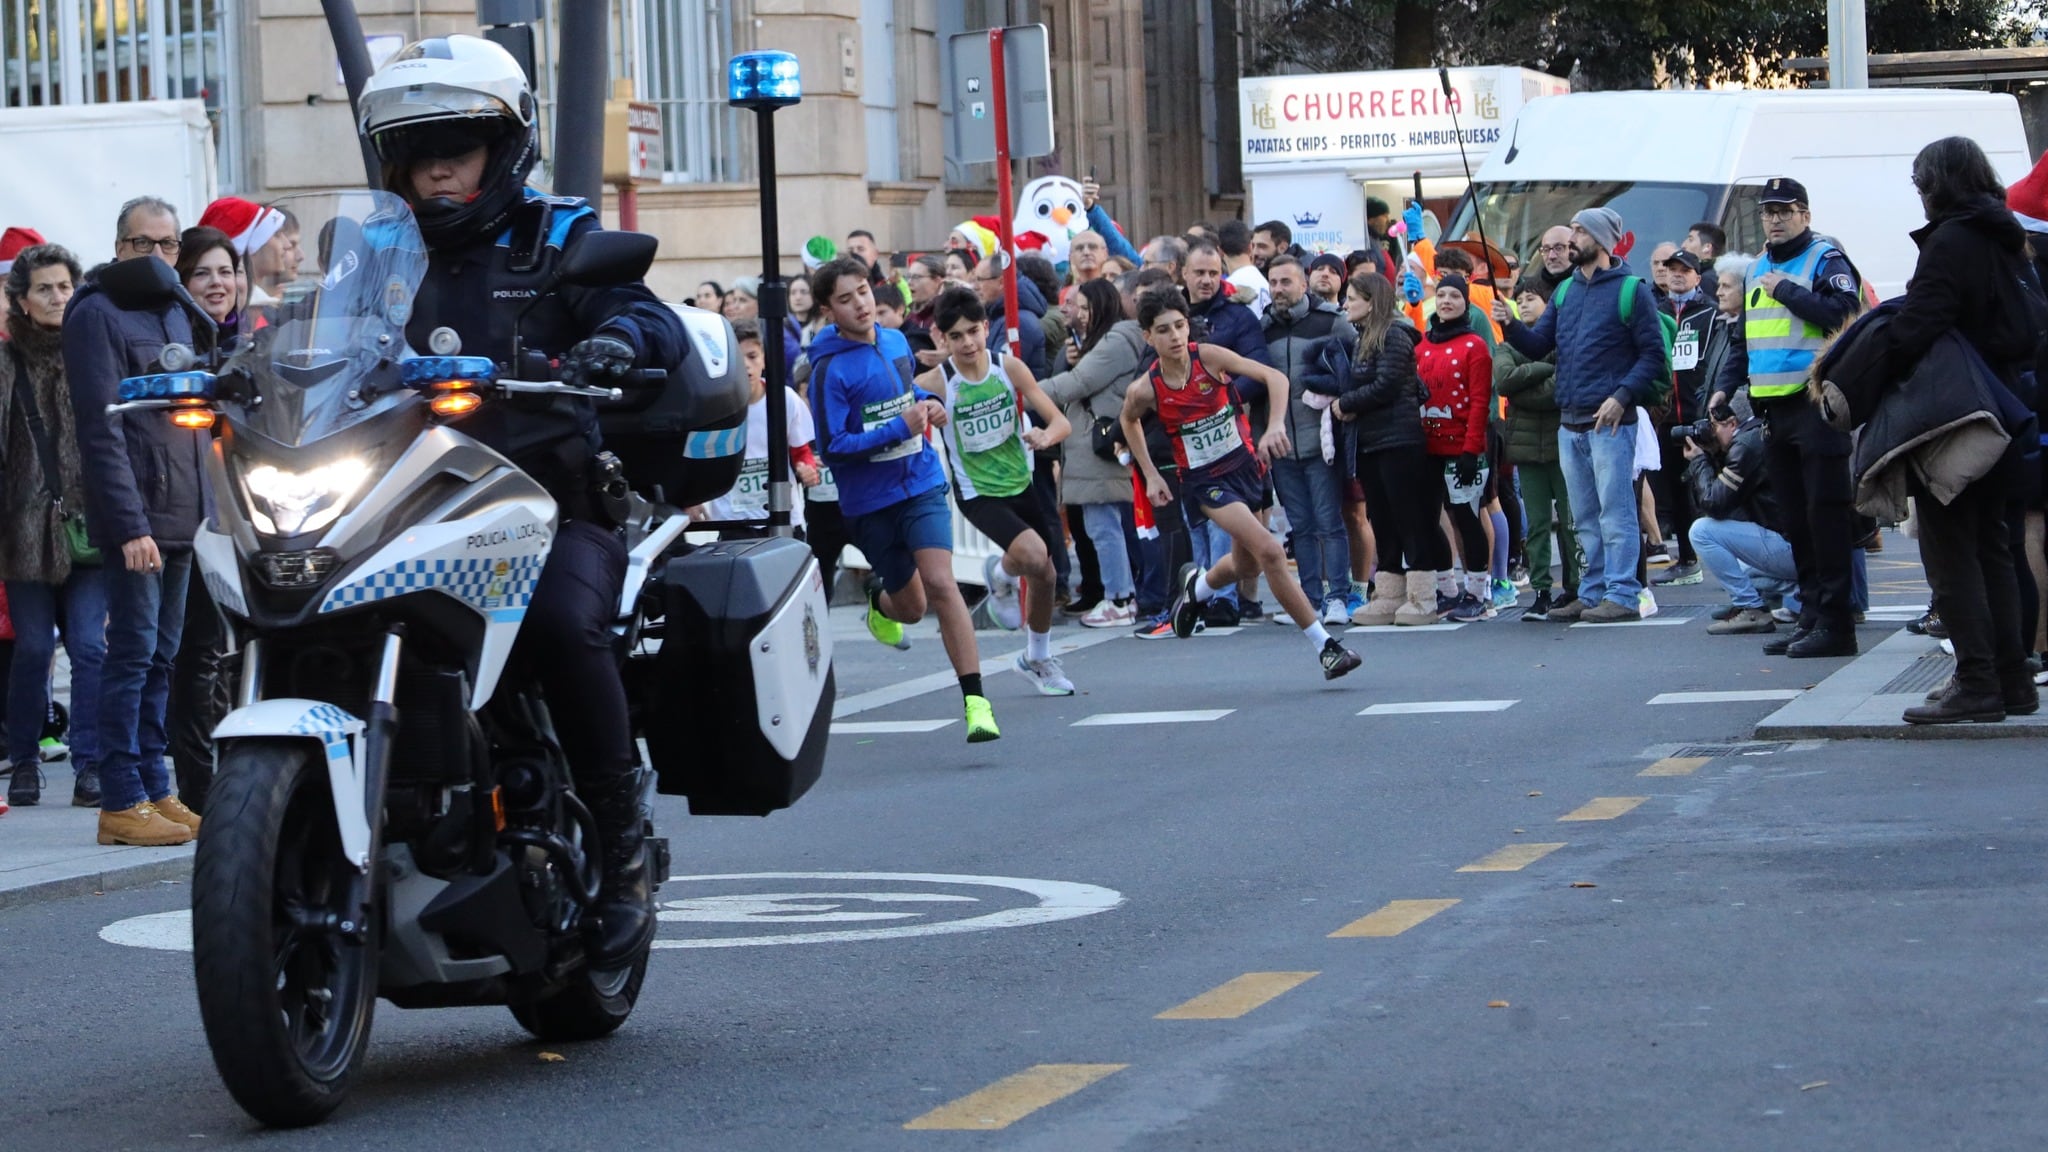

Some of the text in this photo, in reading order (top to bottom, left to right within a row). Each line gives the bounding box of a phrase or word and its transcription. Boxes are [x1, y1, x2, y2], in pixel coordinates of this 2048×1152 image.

[1283, 87, 1462, 122] CHURRERIA
[1248, 138, 1292, 154] PATATAS
[1296, 136, 1328, 152] CHIPS
[1340, 133, 1397, 150] PERRITOS
[1409, 127, 1500, 147] HAMBURGUESAS
[963, 408, 1013, 437] 3004
[1191, 422, 1233, 450] 3142
